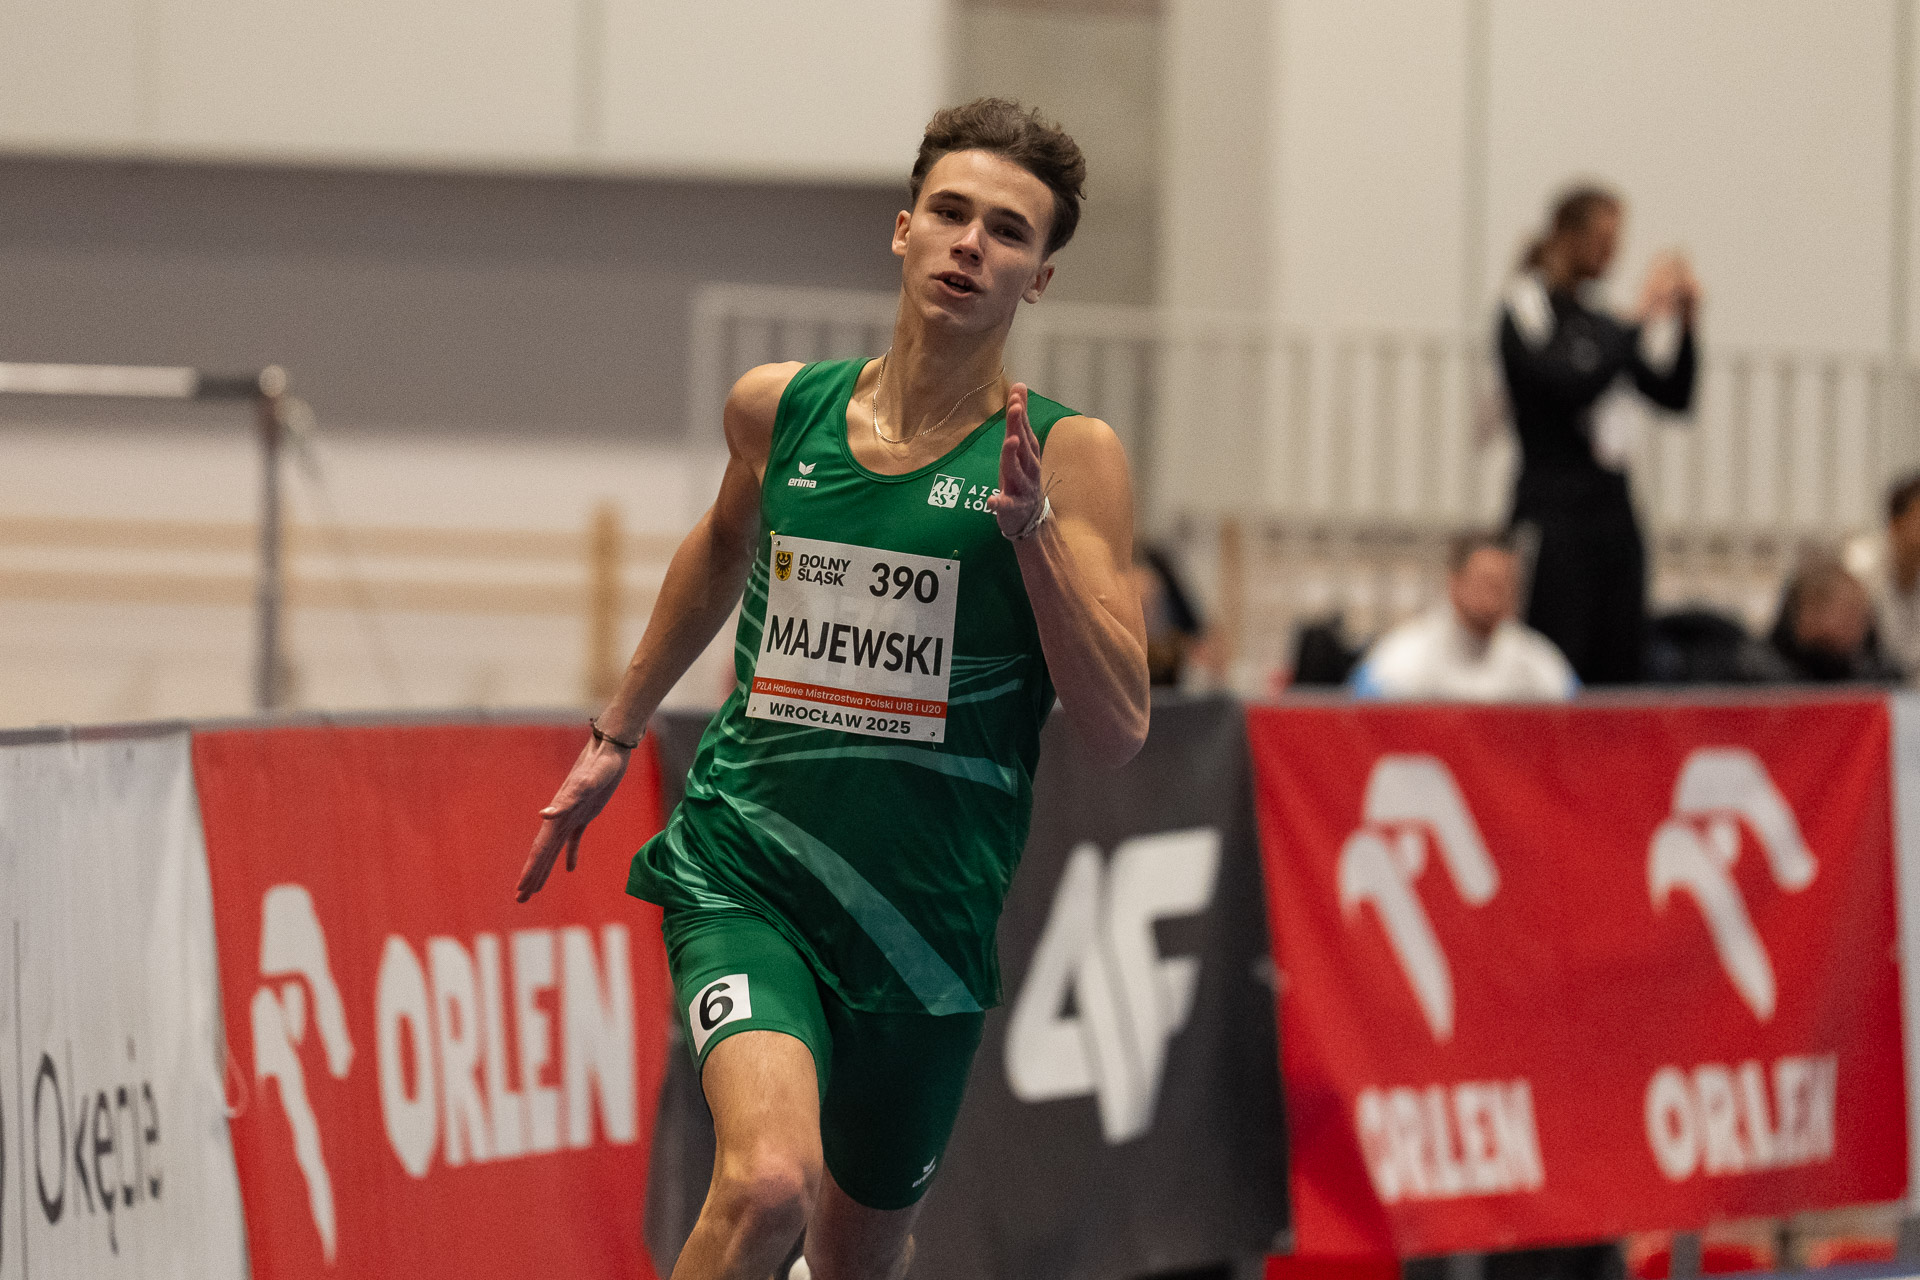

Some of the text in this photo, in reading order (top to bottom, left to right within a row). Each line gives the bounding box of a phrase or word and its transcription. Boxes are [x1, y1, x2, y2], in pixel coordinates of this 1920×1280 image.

[788, 477, 817, 489] erima
[797, 565, 845, 586] ŚLĄSK
[799, 554, 851, 572] DOLNY
[869, 562, 939, 604] 390
[766, 615, 944, 677] MAJEWSKI
[756, 681, 942, 715] PZLA Halowe Mistrzostwa Polski U18 i U20
[769, 701, 911, 735] WROCŁAW 2025
[699, 982, 734, 1031] 6
[1006, 829, 1222, 1145] 4F
[375, 923, 638, 1179] ORLEN
[1644, 1050, 1838, 1182] ORLEN
